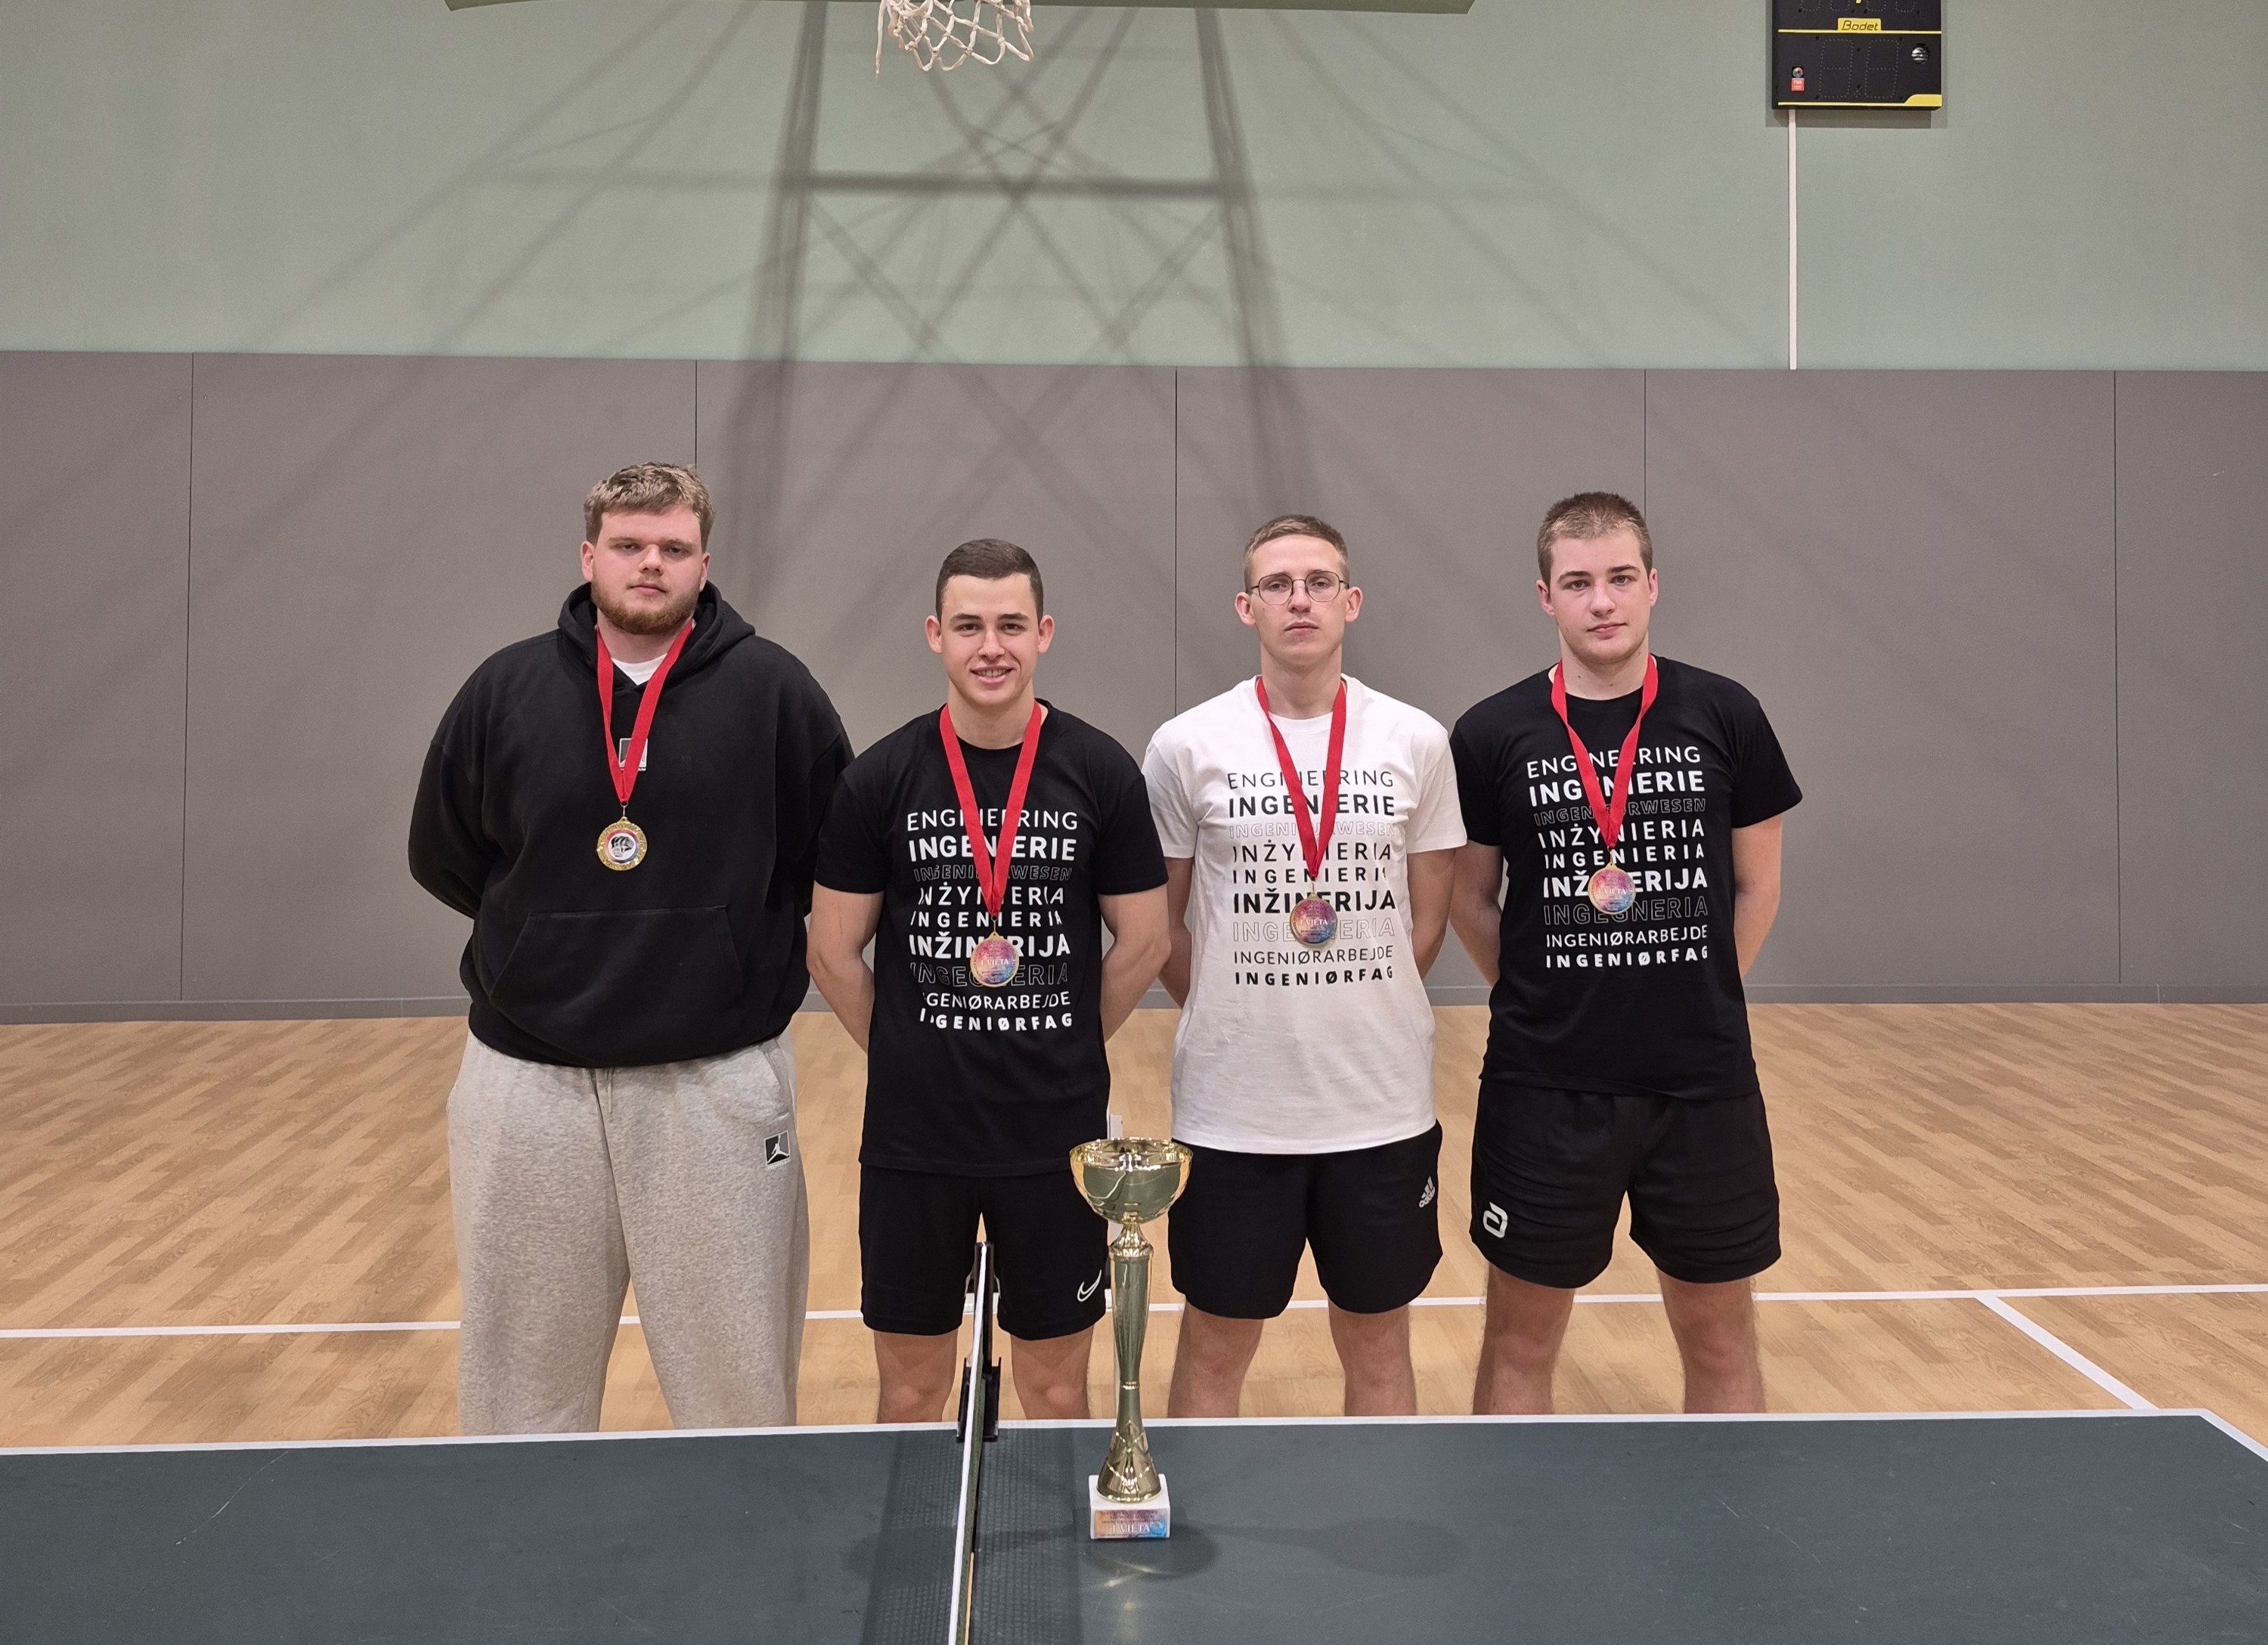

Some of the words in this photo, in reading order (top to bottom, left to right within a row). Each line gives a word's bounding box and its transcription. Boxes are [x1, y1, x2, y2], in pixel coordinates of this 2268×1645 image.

[1841, 20, 1878, 31] Bodet
[1527, 746, 1701, 779] ENGNERING
[1227, 770, 1393, 789] ENGIERING
[1529, 770, 1706, 807] INGNIERIE
[1229, 794, 1394, 818] INGENERIE
[1533, 798, 1706, 826] INGENRWESEN
[907, 808, 1077, 832] ENGIERING
[1229, 821, 1394, 839] INGENIWESEN
[909, 835, 1077, 862] INGENERIE
[1232, 839, 1390, 863] INŻYIERIA
[1544, 843, 1704, 869] INGENIERIA
[1543, 867, 1708, 898] INŽERIJA
[1232, 918, 1395, 942] INGEERIA
[1546, 925, 1708, 947] INGENIØRARBEJDE
[909, 931, 1070, 959] INŽINRIJA
[1234, 945, 1394, 965] INGENIØRARBEJDE
[1546, 945, 1708, 968] INGENIØRFAG
[910, 962, 1067, 987] INGEERIA
[1235, 965, 1393, 986] INGENIØRFAG
